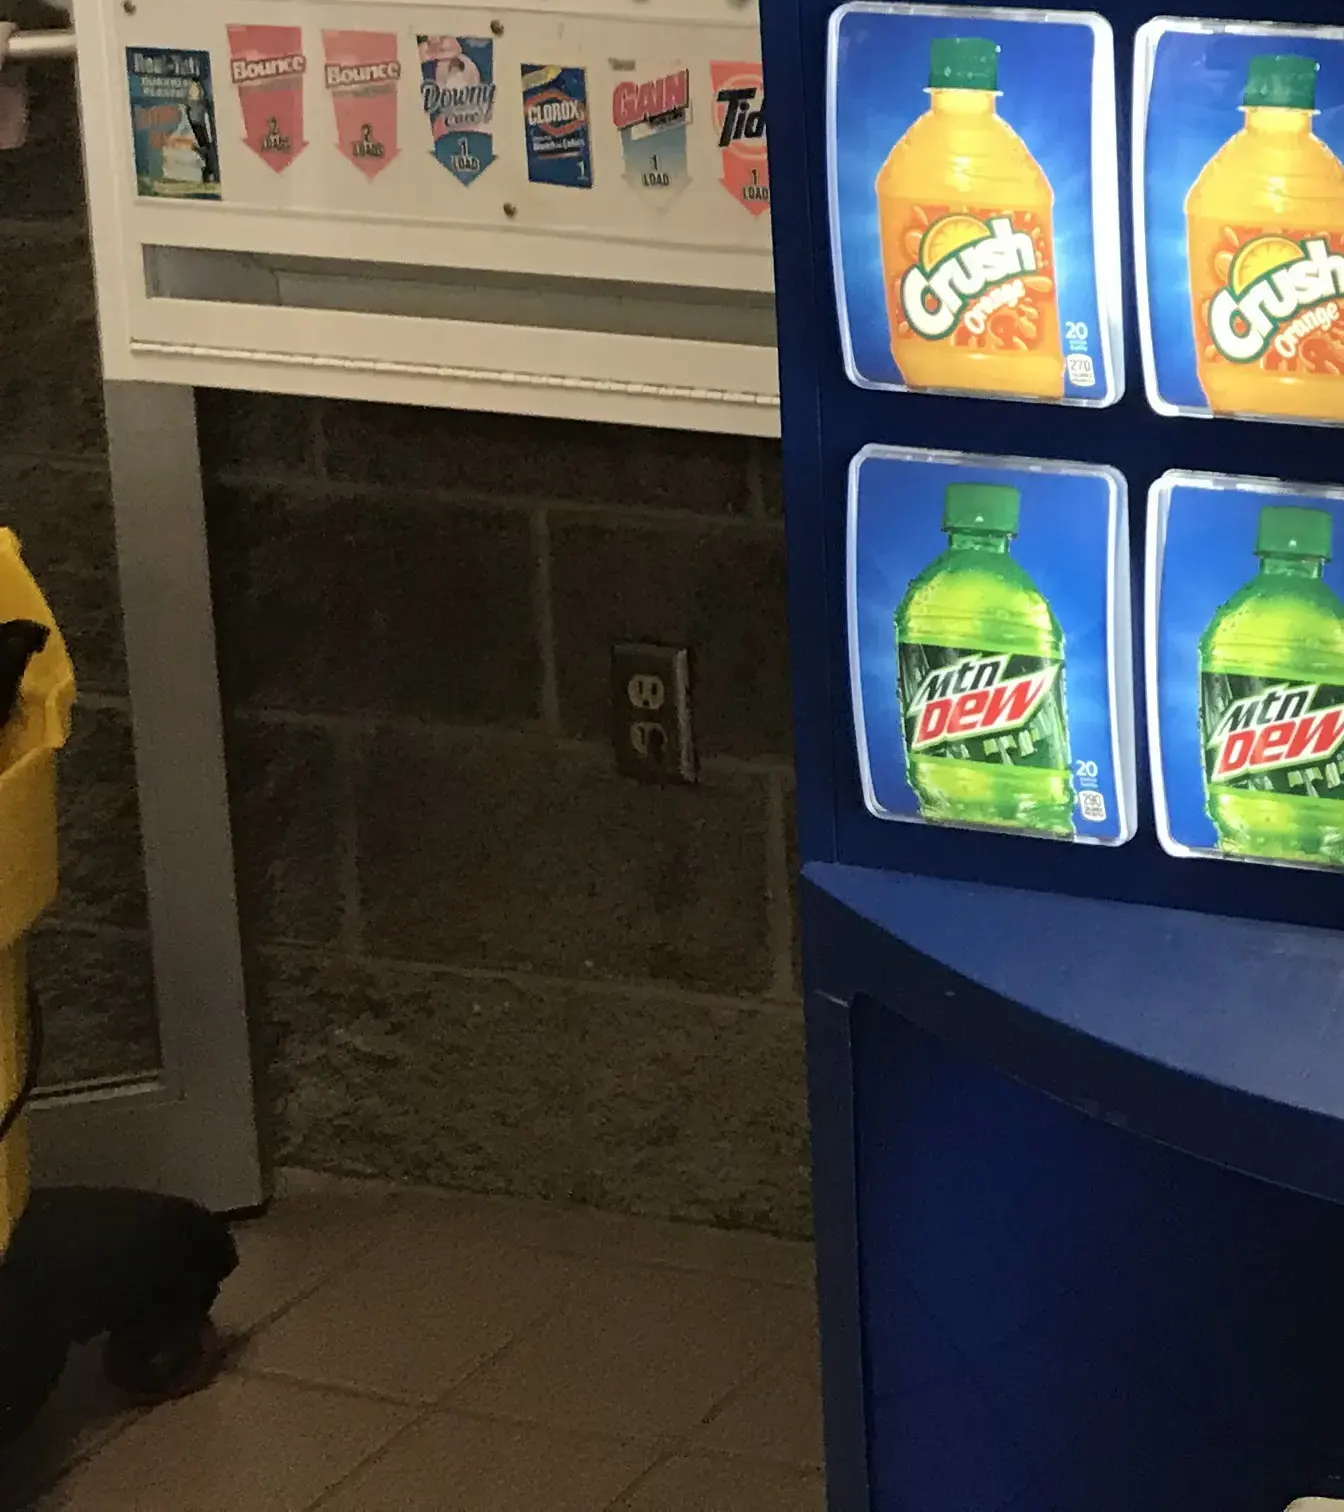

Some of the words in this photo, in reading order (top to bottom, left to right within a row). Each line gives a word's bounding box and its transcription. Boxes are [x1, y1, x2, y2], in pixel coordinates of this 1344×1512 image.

[232, 58, 304, 81] Bounce
[327, 63, 399, 84] Bounce
[422, 83, 496, 119] Downy
[613, 70, 689, 129] GAIN
[528, 101, 580, 125] CLOROX
[717, 87, 766, 147] Tid
[652, 155, 658, 170] 1
[644, 173, 669, 186] LOAD
[752, 170, 758, 184] 1
[903, 218, 1037, 331] Crush
[1066, 321, 1087, 339] 20
[1070, 359, 1090, 371] 270
[1076, 760, 1097, 777] 20
